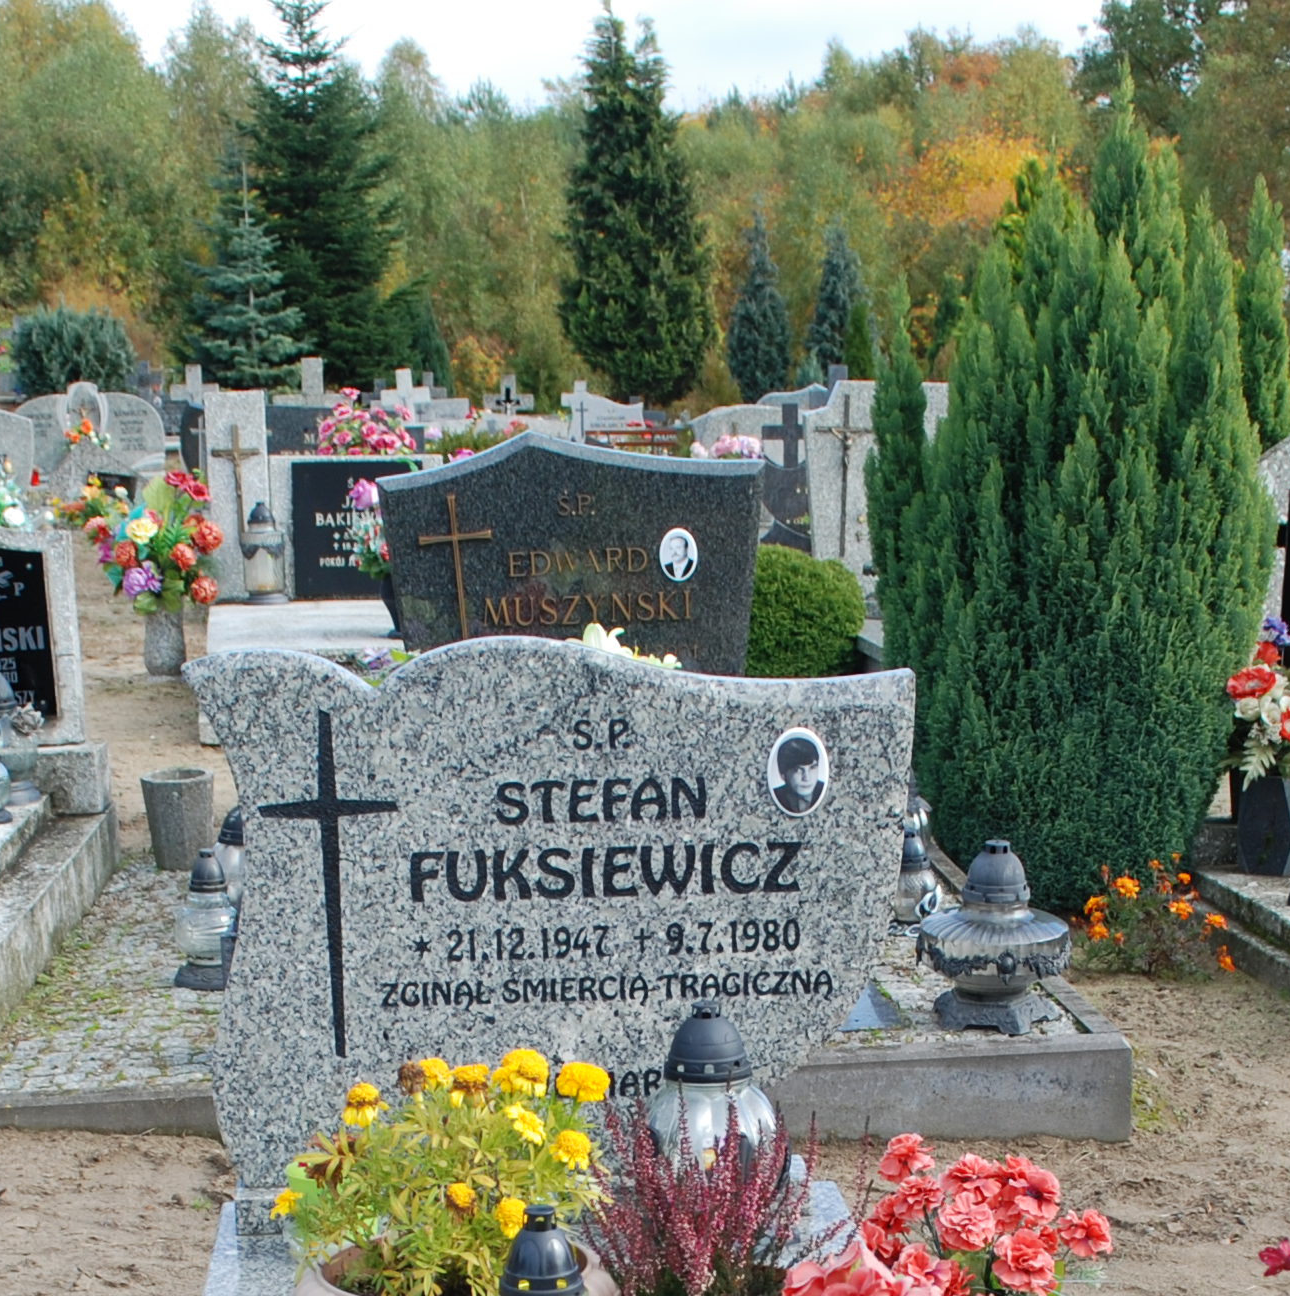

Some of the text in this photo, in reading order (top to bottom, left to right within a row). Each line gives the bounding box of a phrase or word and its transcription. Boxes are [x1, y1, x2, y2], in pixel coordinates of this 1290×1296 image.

[508, 544, 650, 578] EDWARD
[495, 776, 708, 826] STEFAN
[409, 840, 803, 902] FUKSIEWICZ
[445, 917, 802, 963] 21.12.1947 9.7.1980
